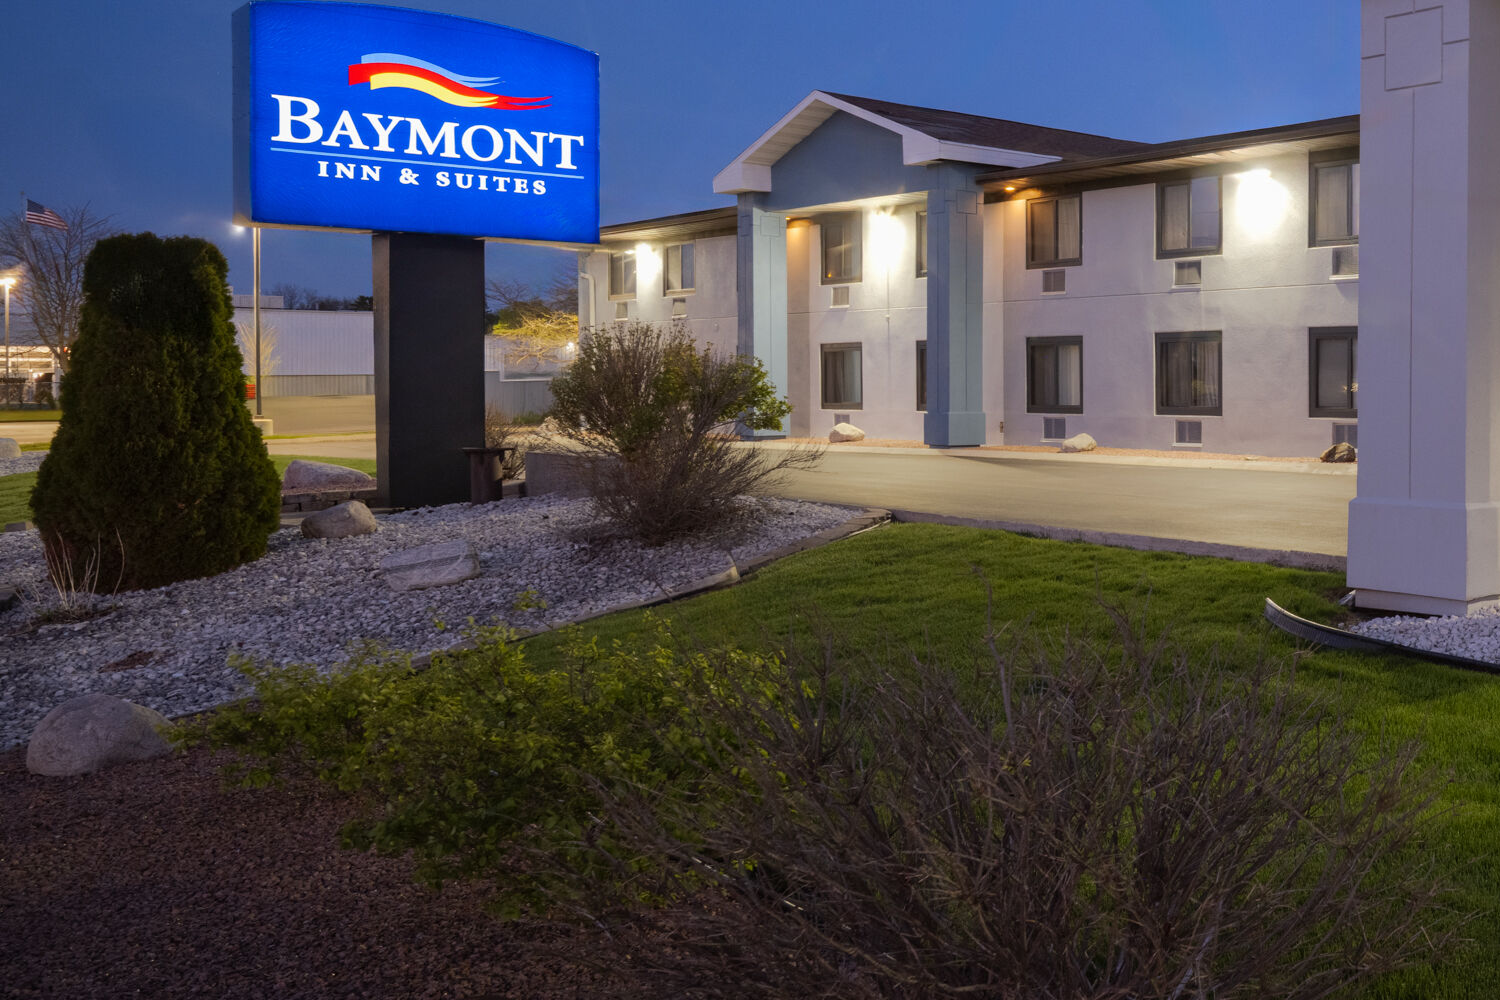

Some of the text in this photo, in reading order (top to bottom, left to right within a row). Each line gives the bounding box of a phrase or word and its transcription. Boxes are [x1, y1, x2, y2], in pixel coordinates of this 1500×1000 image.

[270, 93, 585, 170] BAYMONT
[317, 160, 547, 195] INN & SUITES
